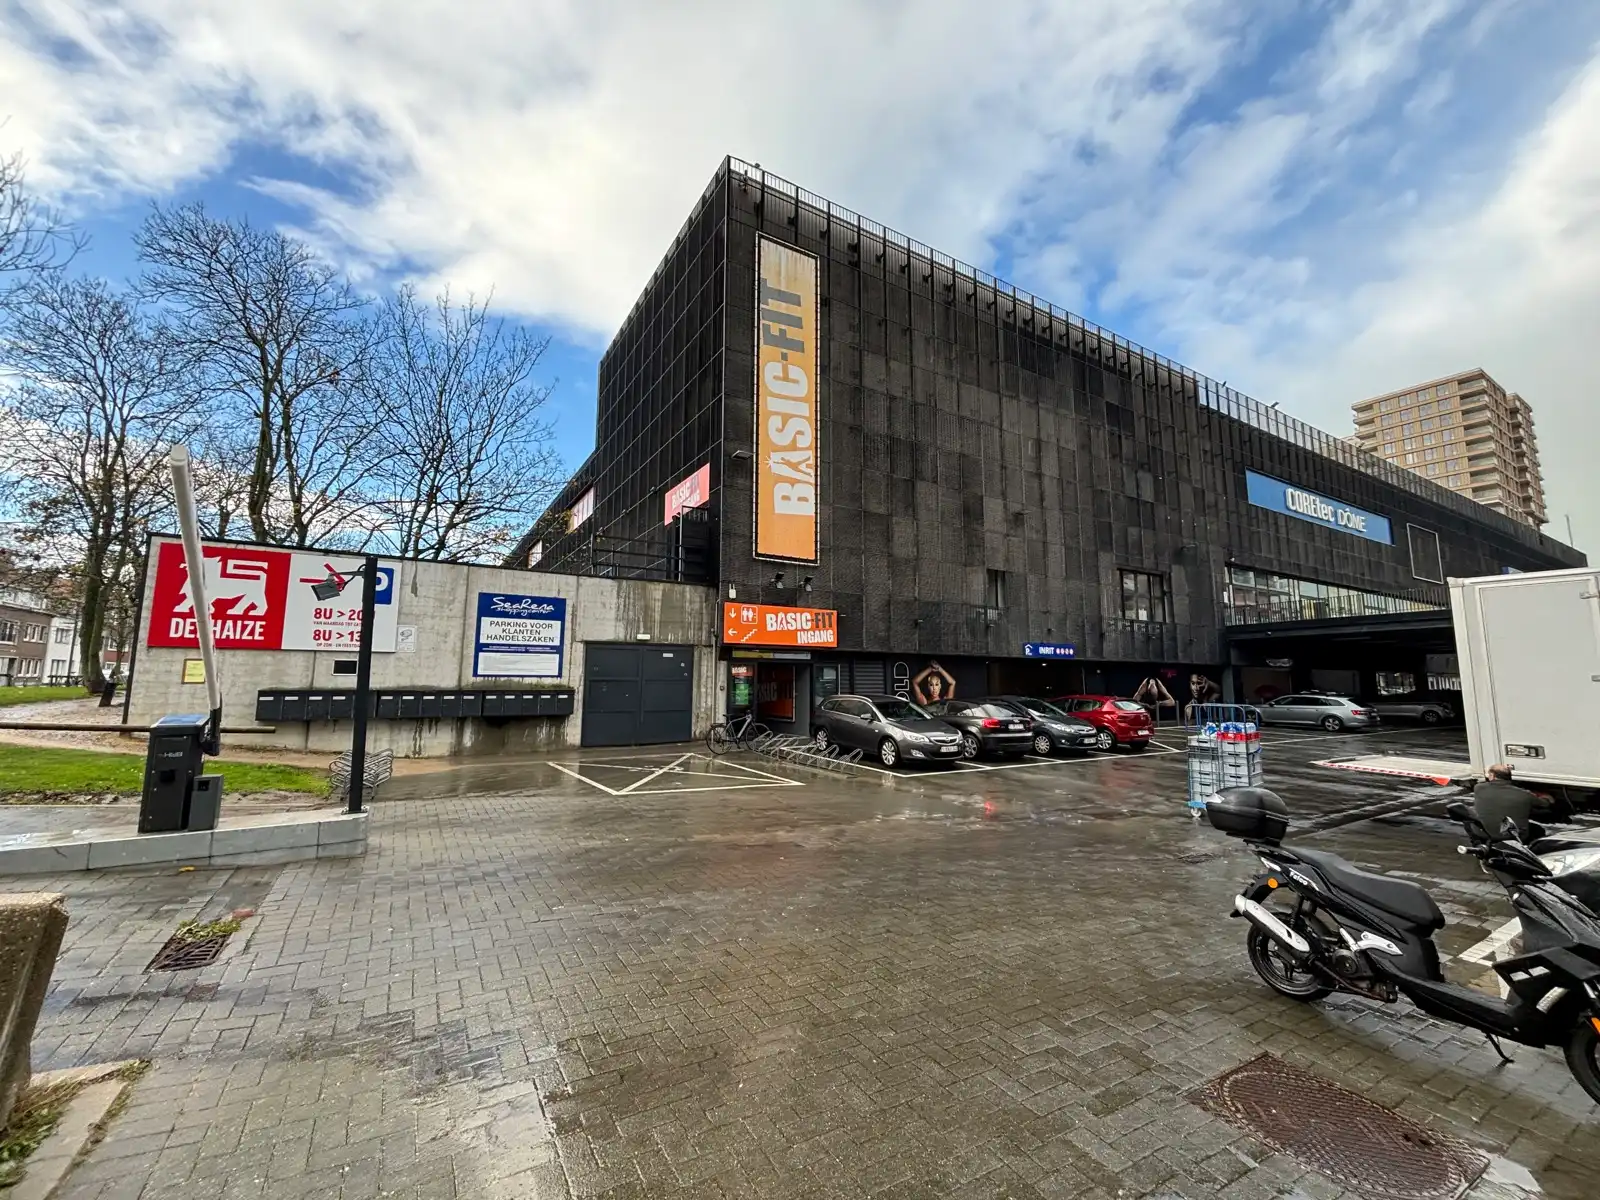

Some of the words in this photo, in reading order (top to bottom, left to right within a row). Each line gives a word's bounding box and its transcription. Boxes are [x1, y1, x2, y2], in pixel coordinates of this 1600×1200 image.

[759, 277, 815, 516] BASIC-FIT
[1286, 489, 1335, 521] COREtec
[1337, 508, 1367, 532] DÔME
[313, 608, 332, 620] 8U
[489, 620, 528, 629] PARKING
[530, 622, 553, 630] VOOR
[766, 611, 834, 632] BASIC-FIT
[169, 617, 266, 640] DEHAIZE
[502, 627, 541, 636] KLANTEN
[313, 629, 332, 641] 8U
[486, 634, 555, 643] HANDELSZAKEN
[797, 630, 834, 644] INGANG
[1039, 646, 1054, 655] INRIT
